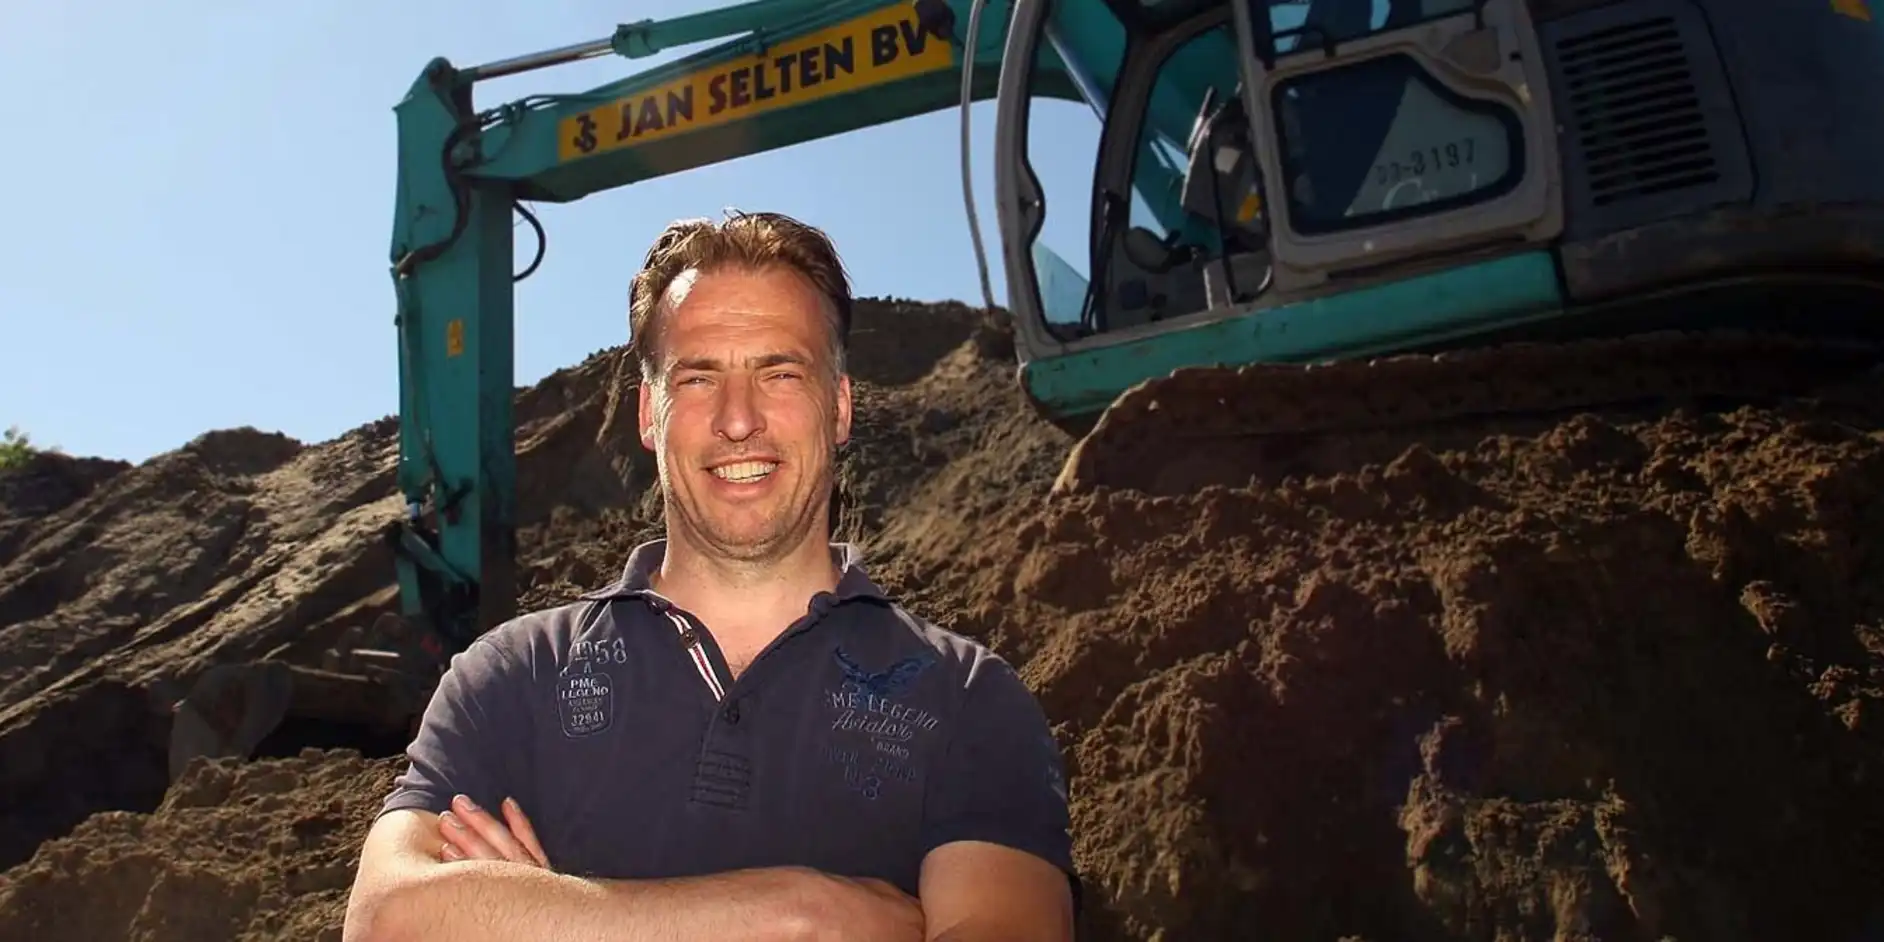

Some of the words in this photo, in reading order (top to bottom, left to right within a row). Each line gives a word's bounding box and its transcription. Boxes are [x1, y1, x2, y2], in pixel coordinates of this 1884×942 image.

[617, 85, 694, 141] JAN
[709, 36, 855, 116] SELTEN
[872, 17, 930, 68] BV
